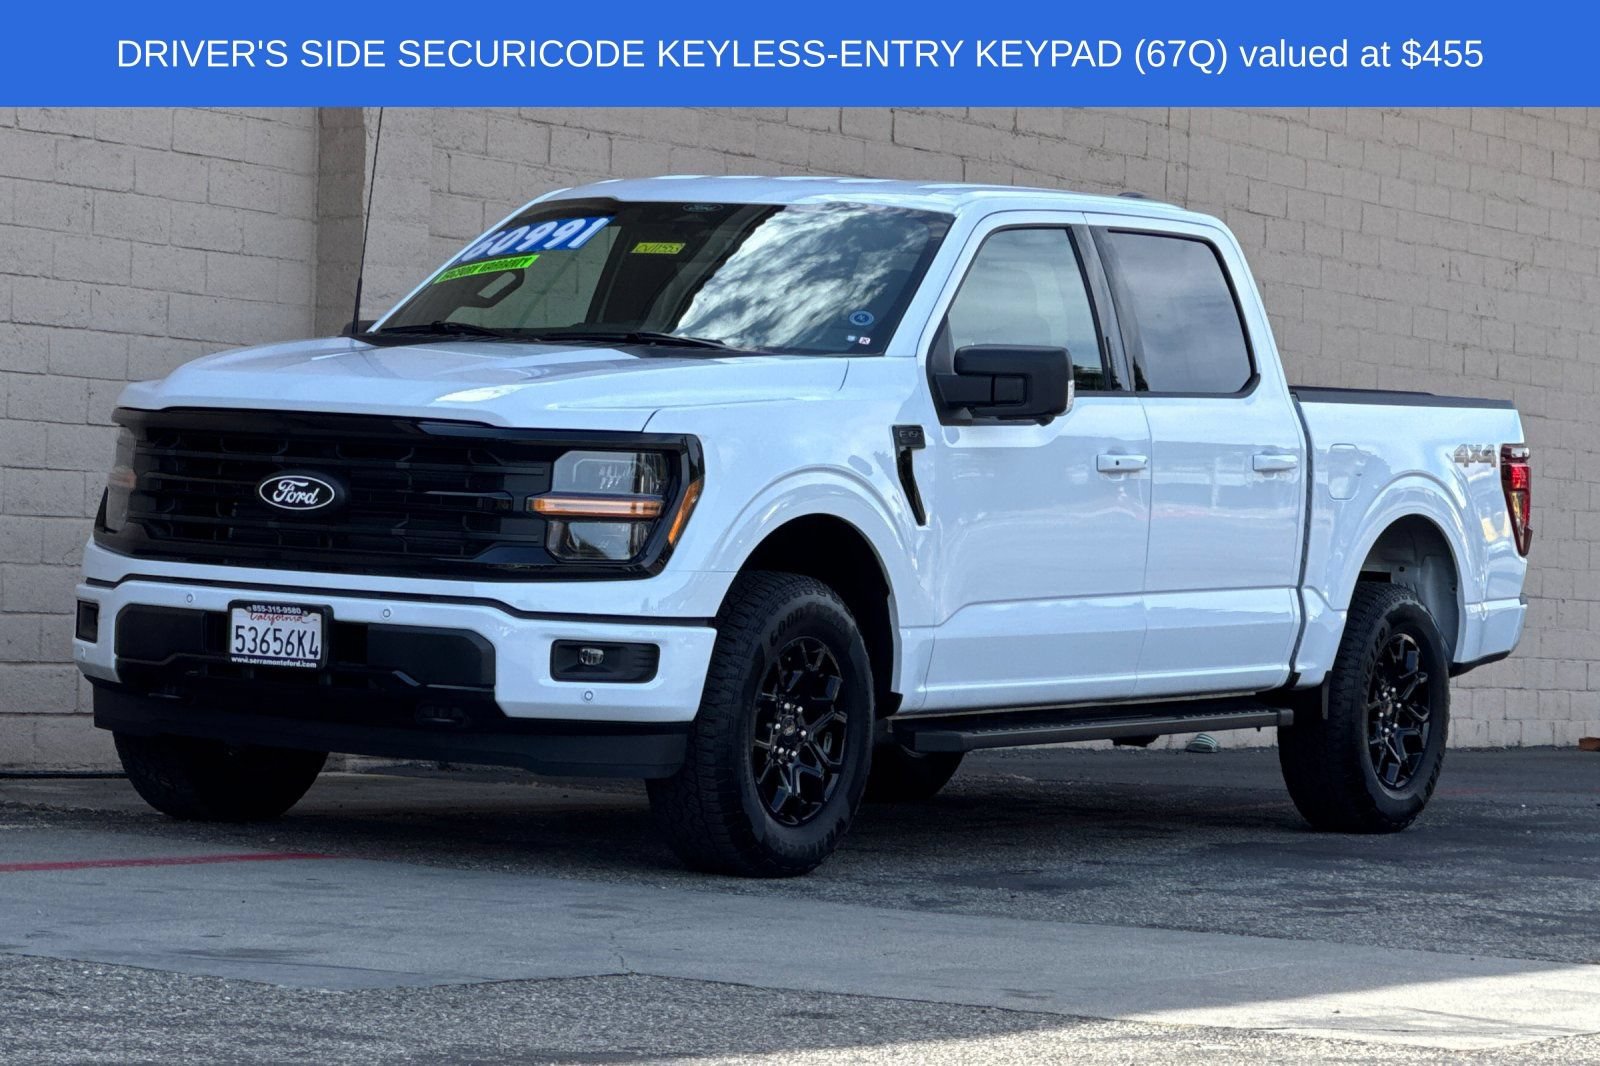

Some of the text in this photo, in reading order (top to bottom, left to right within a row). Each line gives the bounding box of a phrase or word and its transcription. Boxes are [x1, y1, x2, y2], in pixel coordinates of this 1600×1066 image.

[461, 217, 609, 262] 60991
[272, 479, 320, 505] Ford
[235, 625, 319, 658] 53656K4
[230, 656, 317, 669] www.serramonteford.com
